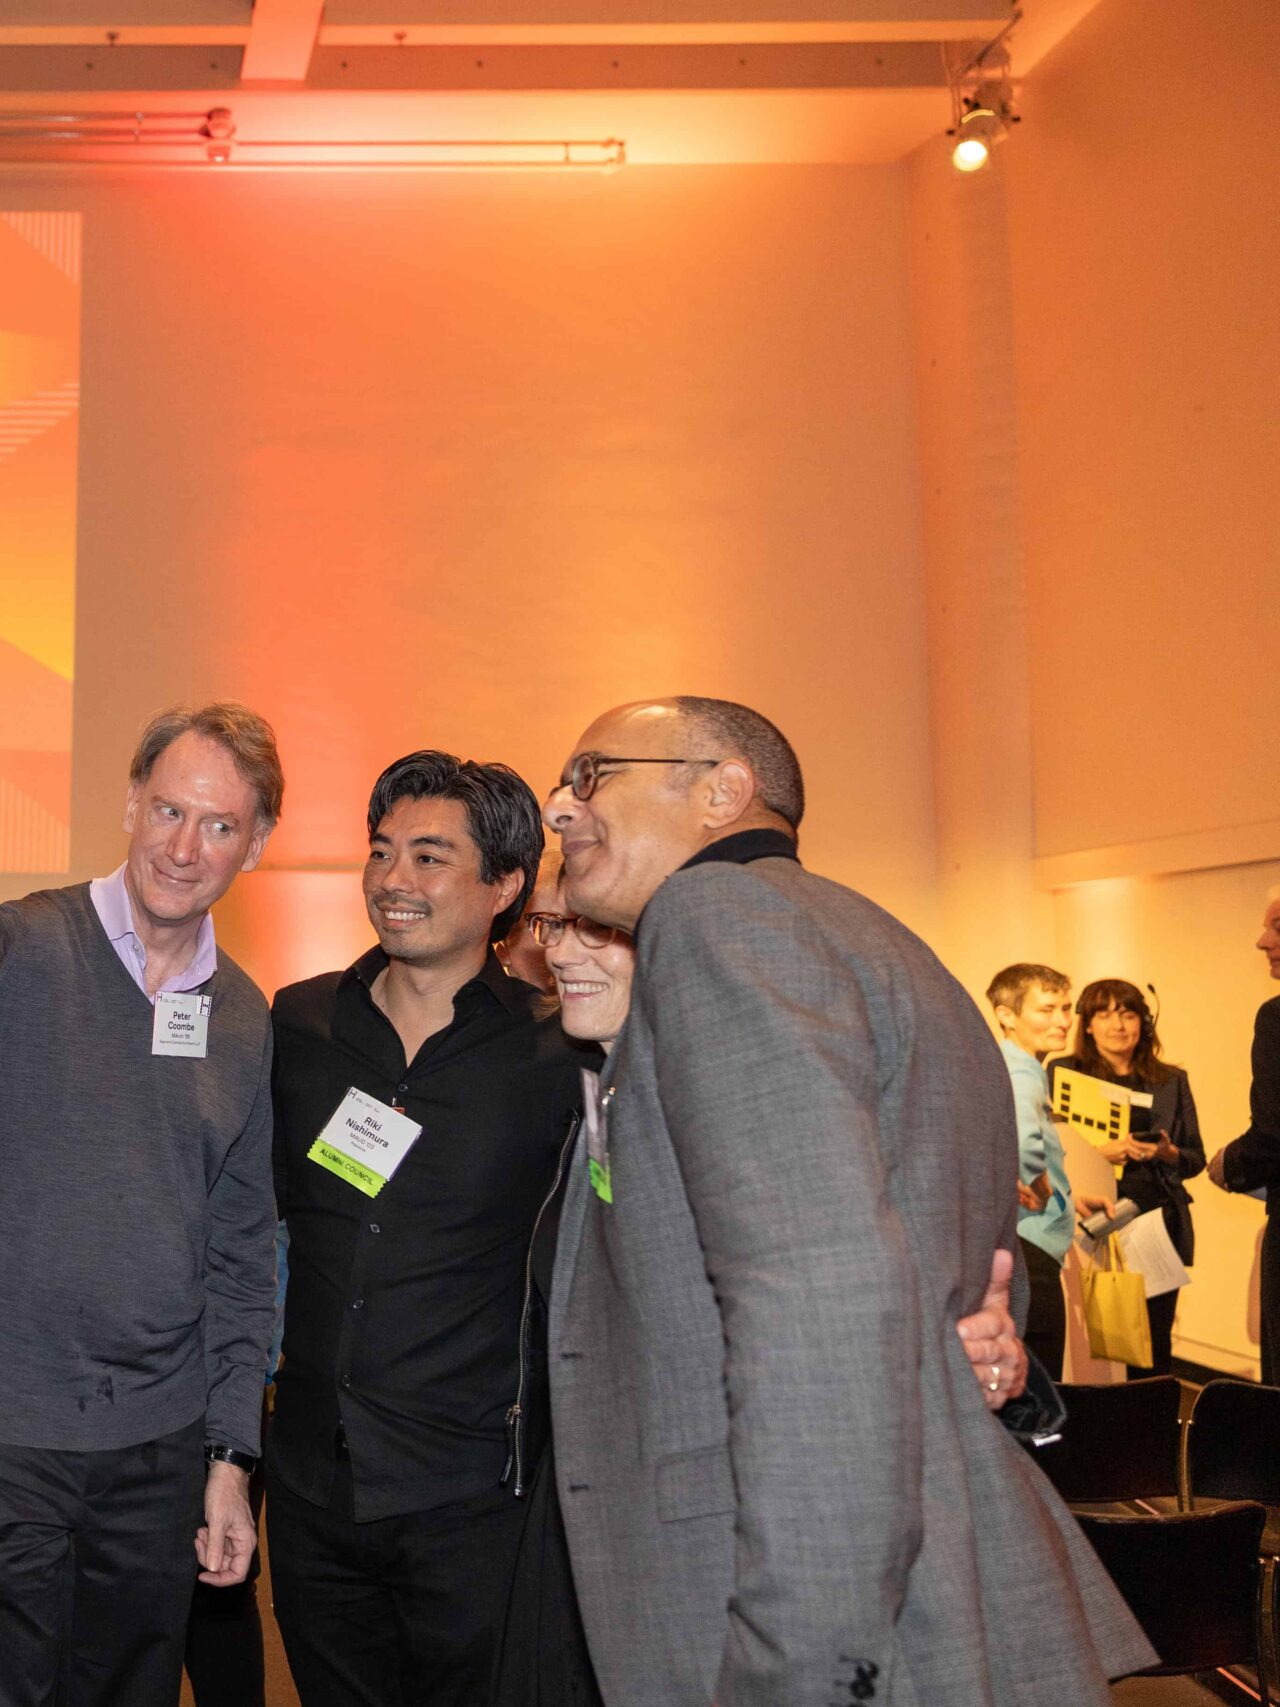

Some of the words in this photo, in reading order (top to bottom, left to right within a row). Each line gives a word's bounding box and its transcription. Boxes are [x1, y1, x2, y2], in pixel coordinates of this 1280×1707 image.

[173, 1011, 191, 1021] Peter
[167, 1021, 195, 1031] Coombe
[364, 1116, 382, 1131] Riki
[345, 1118, 390, 1148] Nishimura
[319, 1148, 345, 1167] ALUMNI
[344, 1163, 374, 1186] COUNCIL
